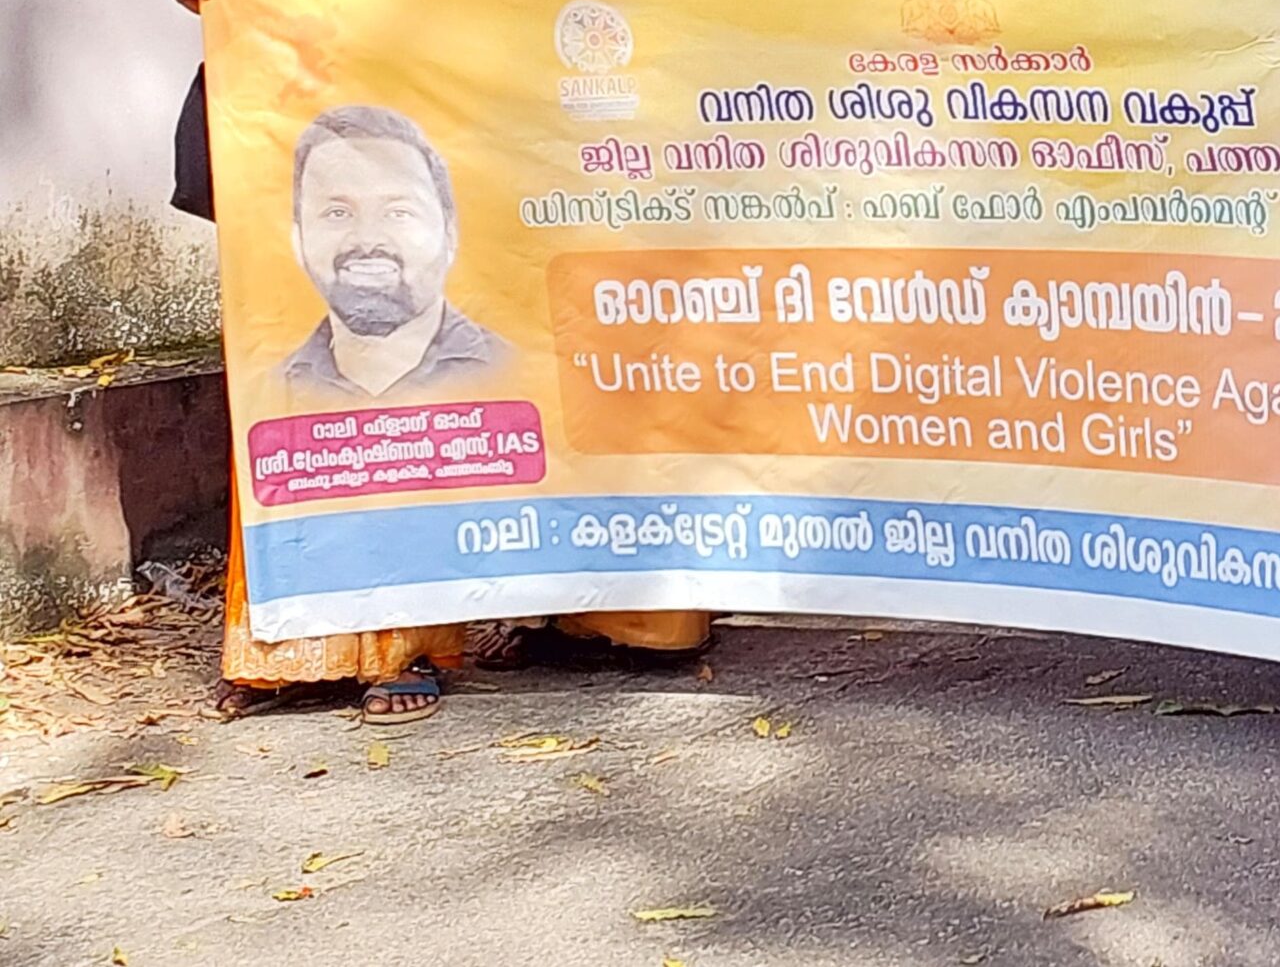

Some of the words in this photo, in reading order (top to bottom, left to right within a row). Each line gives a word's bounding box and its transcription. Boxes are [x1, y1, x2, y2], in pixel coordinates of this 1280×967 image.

[849, 50, 939, 75] കേരള
[952, 46, 1092, 72] സർക്കാർ
[560, 77, 636, 97] SANKALP
[699, 83, 814, 122] വനിത
[829, 83, 932, 127] ശിശു
[946, 82, 1109, 123] വികസന
[1124, 87, 1257, 133] വകുപ്പ്
[581, 137, 652, 179] ജില്ല
[664, 134, 765, 170] വനിത
[779, 132, 1018, 175] ശിശുവികസന
[1032, 135, 1173, 175] ഓഫീസ്,
[704, 186, 837, 224] സങ്കൽപ്
[863, 186, 945, 221] ഹബ്
[953, 187, 1043, 221] ഫോർ
[1056, 190, 1279, 233] എംപവർമെന്റ്
[594, 266, 763, 324] ഓറഞ്ച്
[775, 264, 813, 323] ദി
[829, 267, 990, 325] വേൾഡ്
[716, 362, 756, 393] to
[771, 352, 855, 393] End
[871, 354, 1002, 404] Digital
[1015, 356, 1201, 408] Violence
[312, 416, 358, 439] റാലി
[433, 407, 484, 430] ഓഫ്
[497, 431, 540, 454] IAS
[808, 404, 972, 448] Women
[988, 413, 1065, 452] and
[457, 507, 540, 555] റാലി
[760, 510, 873, 559] മുതൽ
[884, 510, 956, 567] ജില്ല
[966, 516, 1071, 565] വനിത
